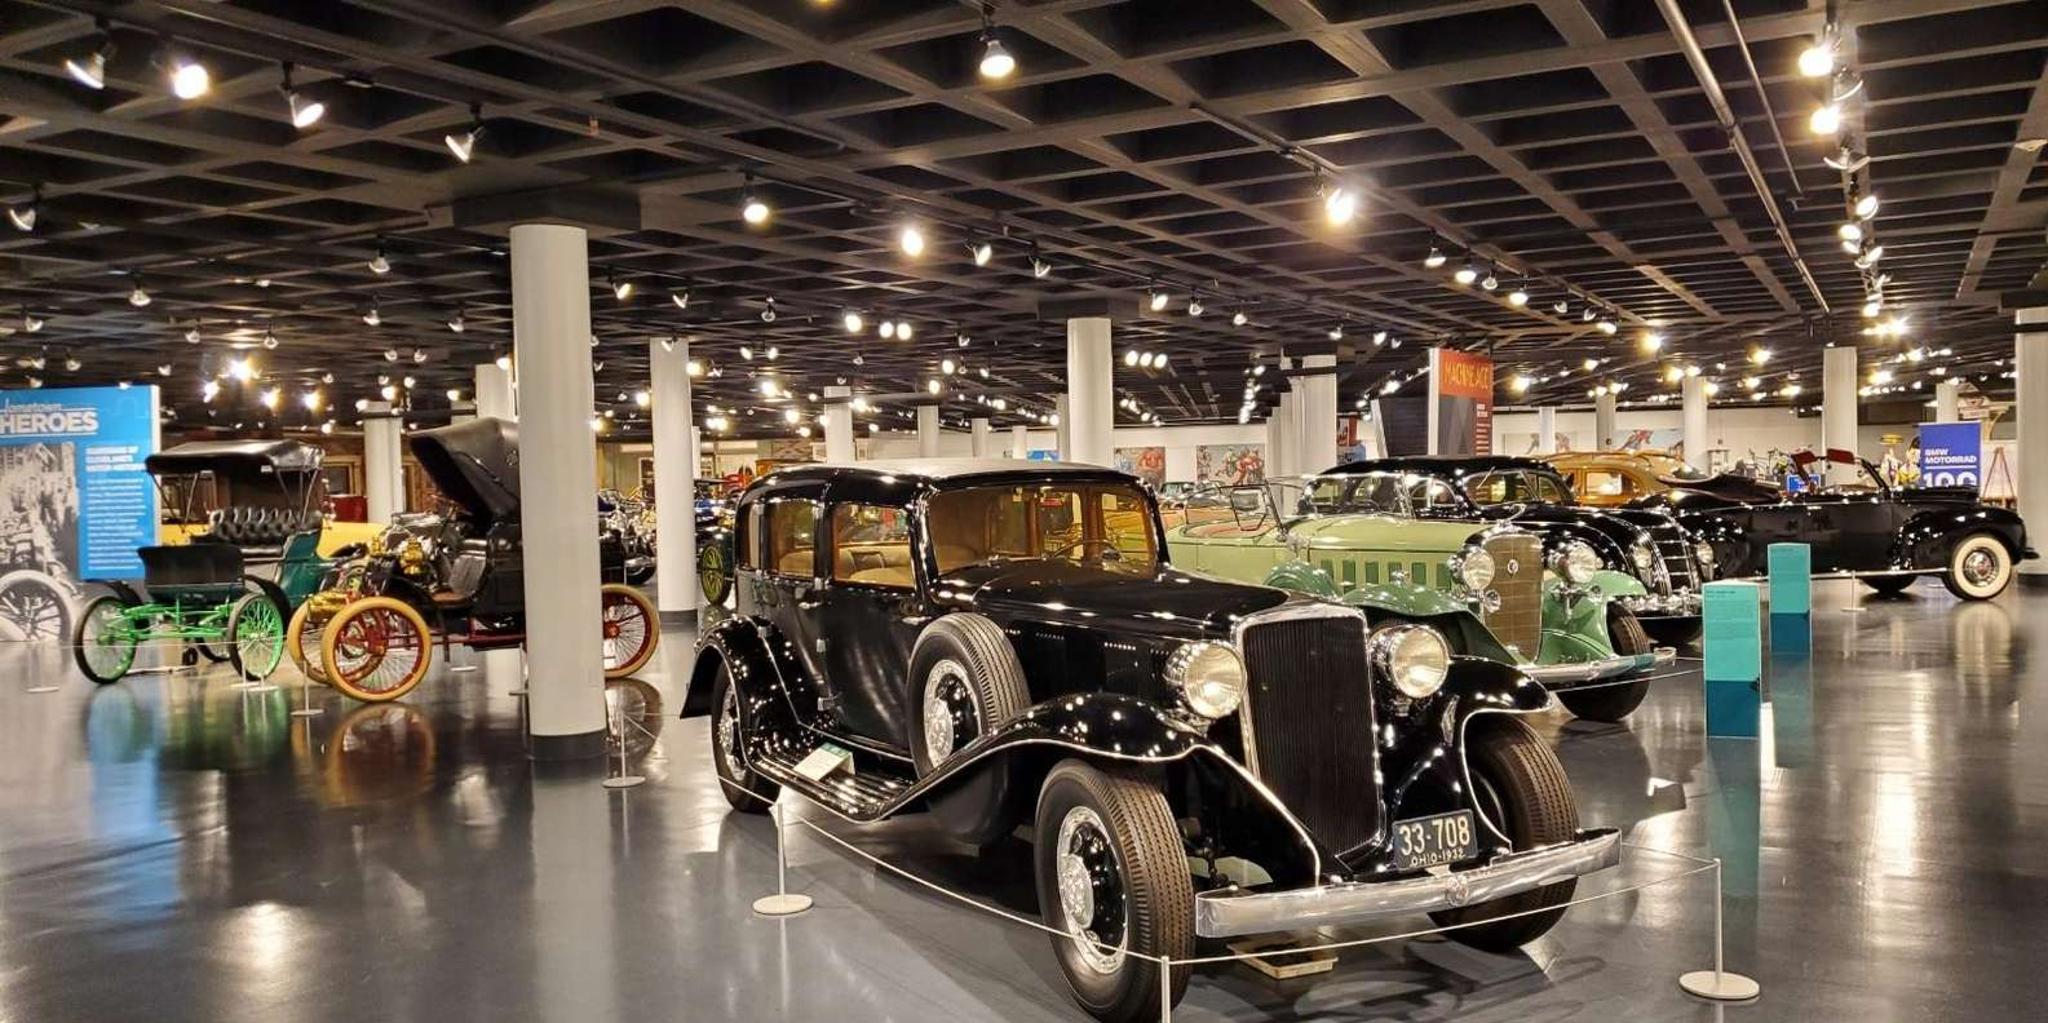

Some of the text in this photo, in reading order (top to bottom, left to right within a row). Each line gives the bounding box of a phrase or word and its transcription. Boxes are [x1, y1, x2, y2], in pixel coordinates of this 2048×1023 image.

[0, 411, 99, 434] HEROES
[1925, 448, 1949, 456] BMW
[1925, 455, 1977, 464] MOTORRAD
[1400, 815, 1470, 856] 33-708
